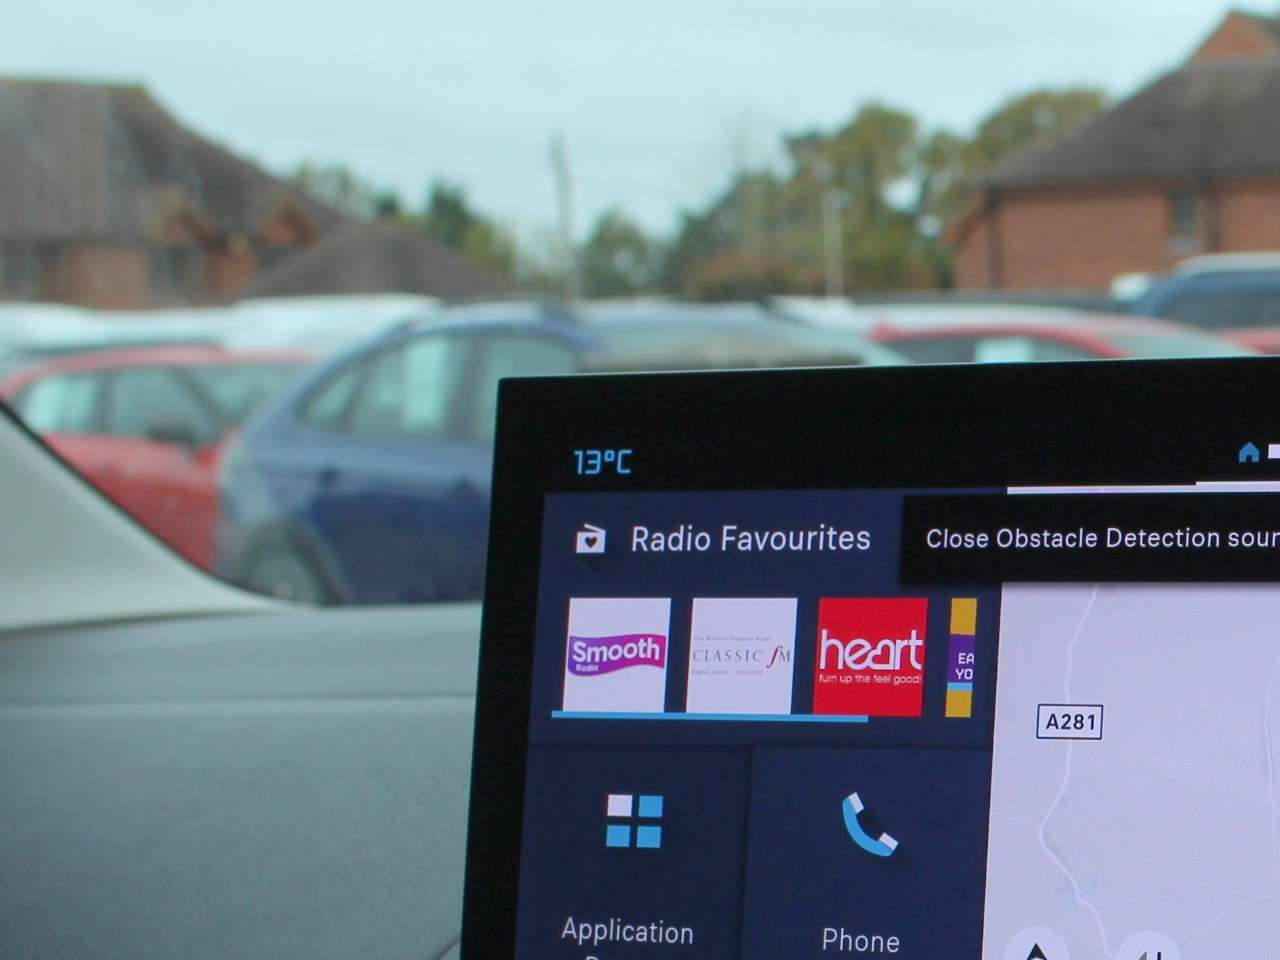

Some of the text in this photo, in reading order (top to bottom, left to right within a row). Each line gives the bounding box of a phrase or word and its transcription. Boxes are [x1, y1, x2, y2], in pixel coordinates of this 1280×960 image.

[631, 524, 871, 552] Radio Favourites
[926, 529, 988, 548] Close
[997, 528, 1097, 548] Obstacle
[1106, 527, 1220, 548] Detection
[572, 637, 660, 664] Smooth
[693, 649, 763, 662] CLASSIC
[820, 629, 923, 670] heart
[576, 663, 599, 673] Radio
[840, 675, 853, 685] up
[855, 673, 871, 683] the
[874, 674, 891, 683] feel
[1046, 713, 1096, 731] A281
[561, 917, 694, 946] Application
[822, 928, 901, 953] Phone
